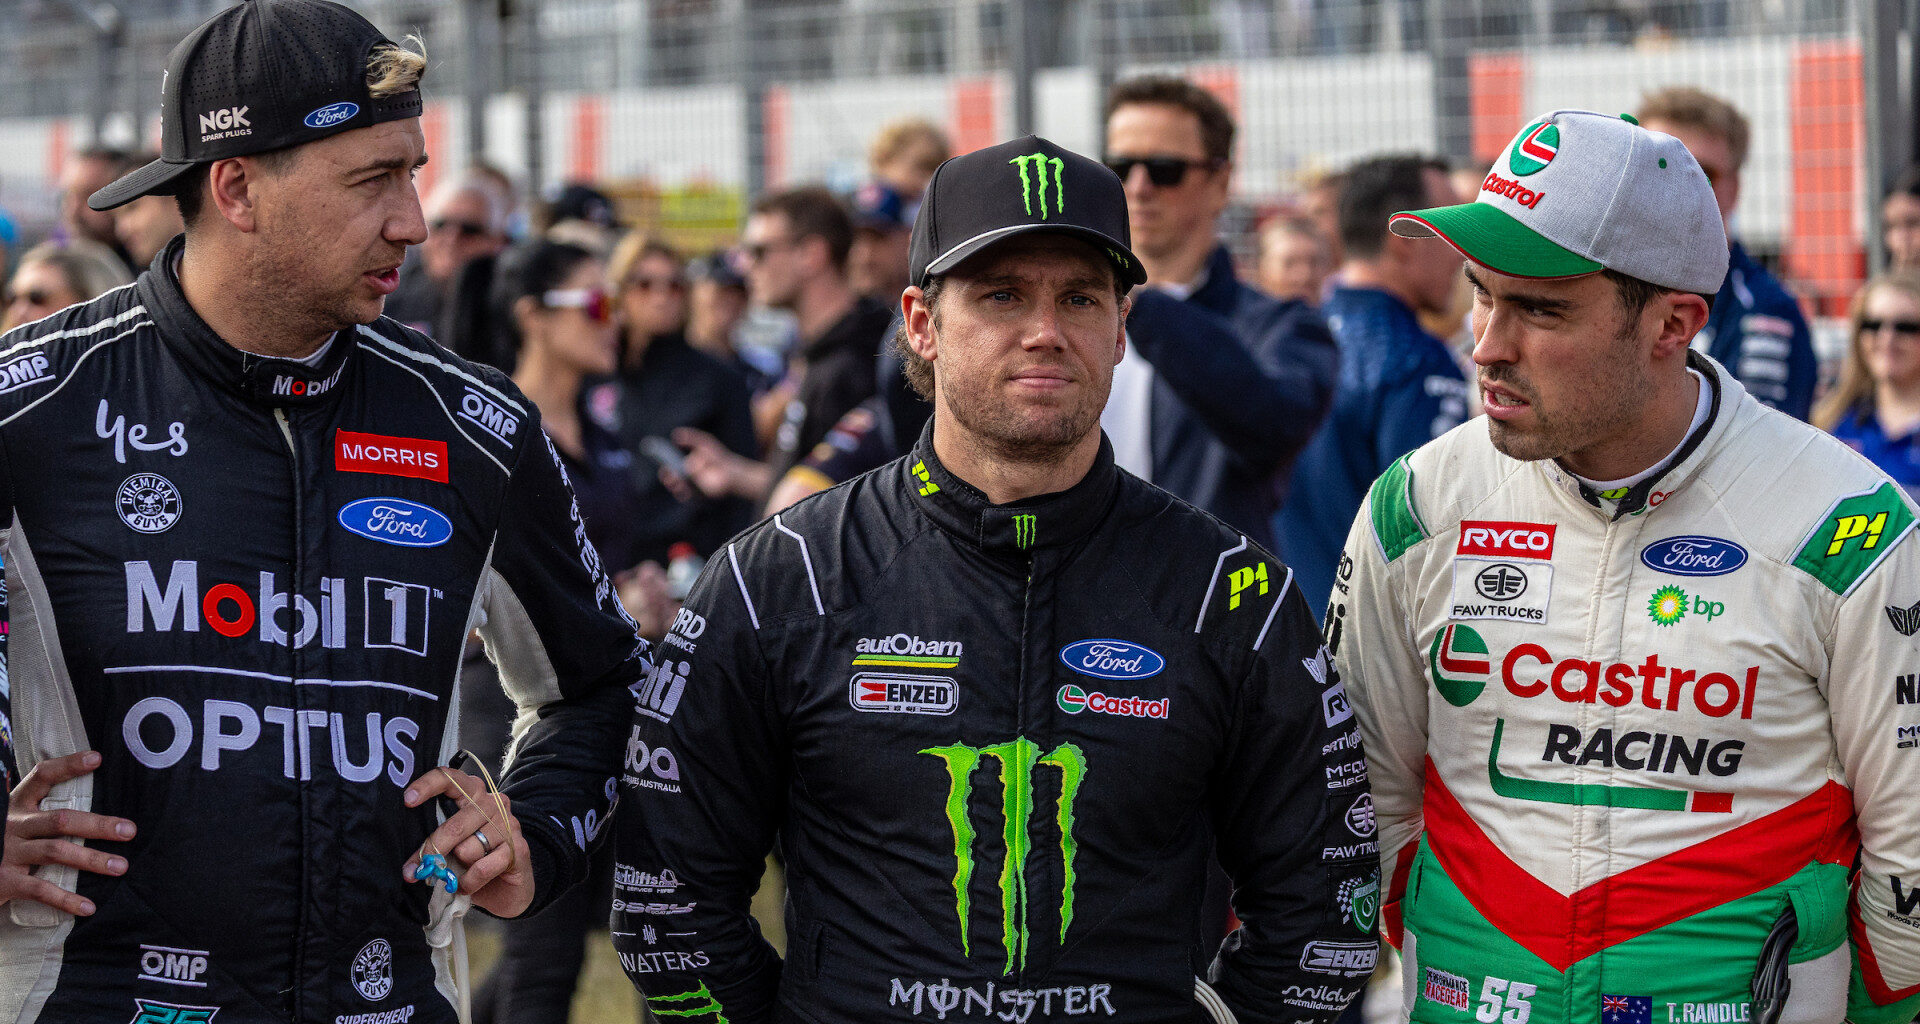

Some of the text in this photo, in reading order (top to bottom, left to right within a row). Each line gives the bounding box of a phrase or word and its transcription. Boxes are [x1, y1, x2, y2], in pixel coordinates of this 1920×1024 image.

[199, 105, 251, 134] NGK
[315, 106, 349, 126] Ford
[201, 128, 252, 143] SPARK PLUGS
[1482, 172, 1546, 210] Castrol
[461, 393, 517, 438] OMP
[342, 443, 439, 468] MORRIS
[121, 477, 177, 505] CHEMICAL
[911, 459, 941, 497] P1
[133, 513, 169, 529] GUYS
[366, 505, 428, 539] Ford
[1824, 511, 1889, 559] P1
[1462, 528, 1549, 550] RYCO
[1663, 541, 1726, 569] Ford
[1227, 562, 1269, 611] P1
[124, 560, 346, 649] Mobil
[384, 586, 408, 646] 1
[1452, 605, 1543, 620] FAW TRUCKS
[1692, 595, 1725, 623] bp
[1082, 643, 1145, 673] Ford
[887, 683, 949, 705] ENZED
[1501, 642, 1760, 720] Castrol
[1088, 692, 1169, 719] Castrol
[122, 696, 420, 788] OPTUS
[1542, 723, 1746, 776] RACING
[639, 779, 682, 793] AUSTRALIA
[1322, 845, 1359, 860] FAW
[141, 951, 208, 981] OMP
[617, 951, 710, 973] WATERS
[1331, 949, 1377, 970] ENZED
[364, 981, 389, 997] GUYS
[1425, 980, 1468, 1009] RACEGEAR
[1476, 976, 1538, 1024] 55
[335, 1004, 415, 1024] SUPERCHEAP
